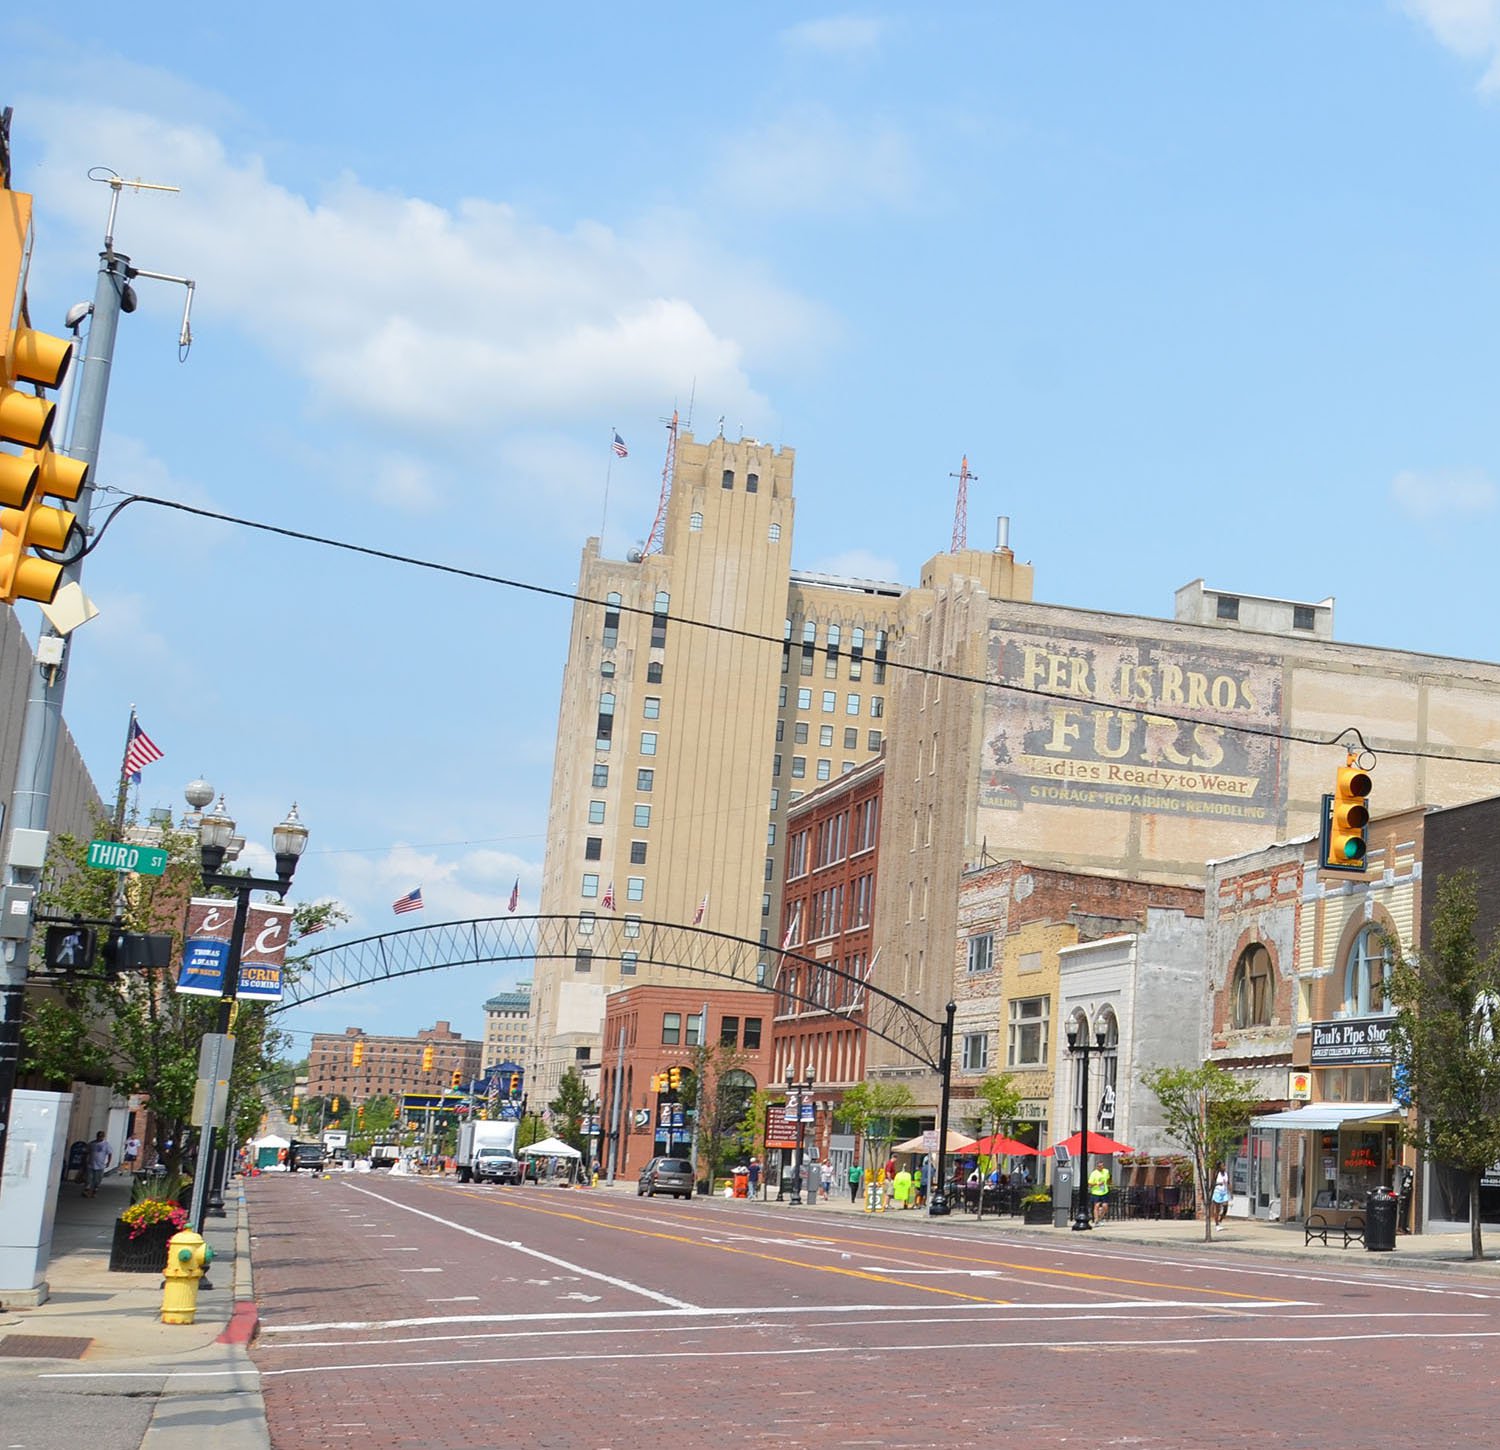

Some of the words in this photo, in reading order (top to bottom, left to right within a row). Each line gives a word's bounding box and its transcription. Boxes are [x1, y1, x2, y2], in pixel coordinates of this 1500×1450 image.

[1044, 705, 1225, 769] FURS
[1034, 759, 1101, 780] adies
[1030, 785, 1098, 803] STORAGE
[1104, 792, 1180, 811] REPAIRING
[1186, 801, 1266, 819] REMODELING
[91, 843, 139, 868] THIRD
[151, 856, 163, 867] ST
[241, 979, 249, 987] IS
[250, 980, 280, 989] COMING
[247, 968, 280, 982] CRIM
[1314, 1027, 1341, 1045] Paul's
[1343, 1026, 1365, 1046] Pipe
